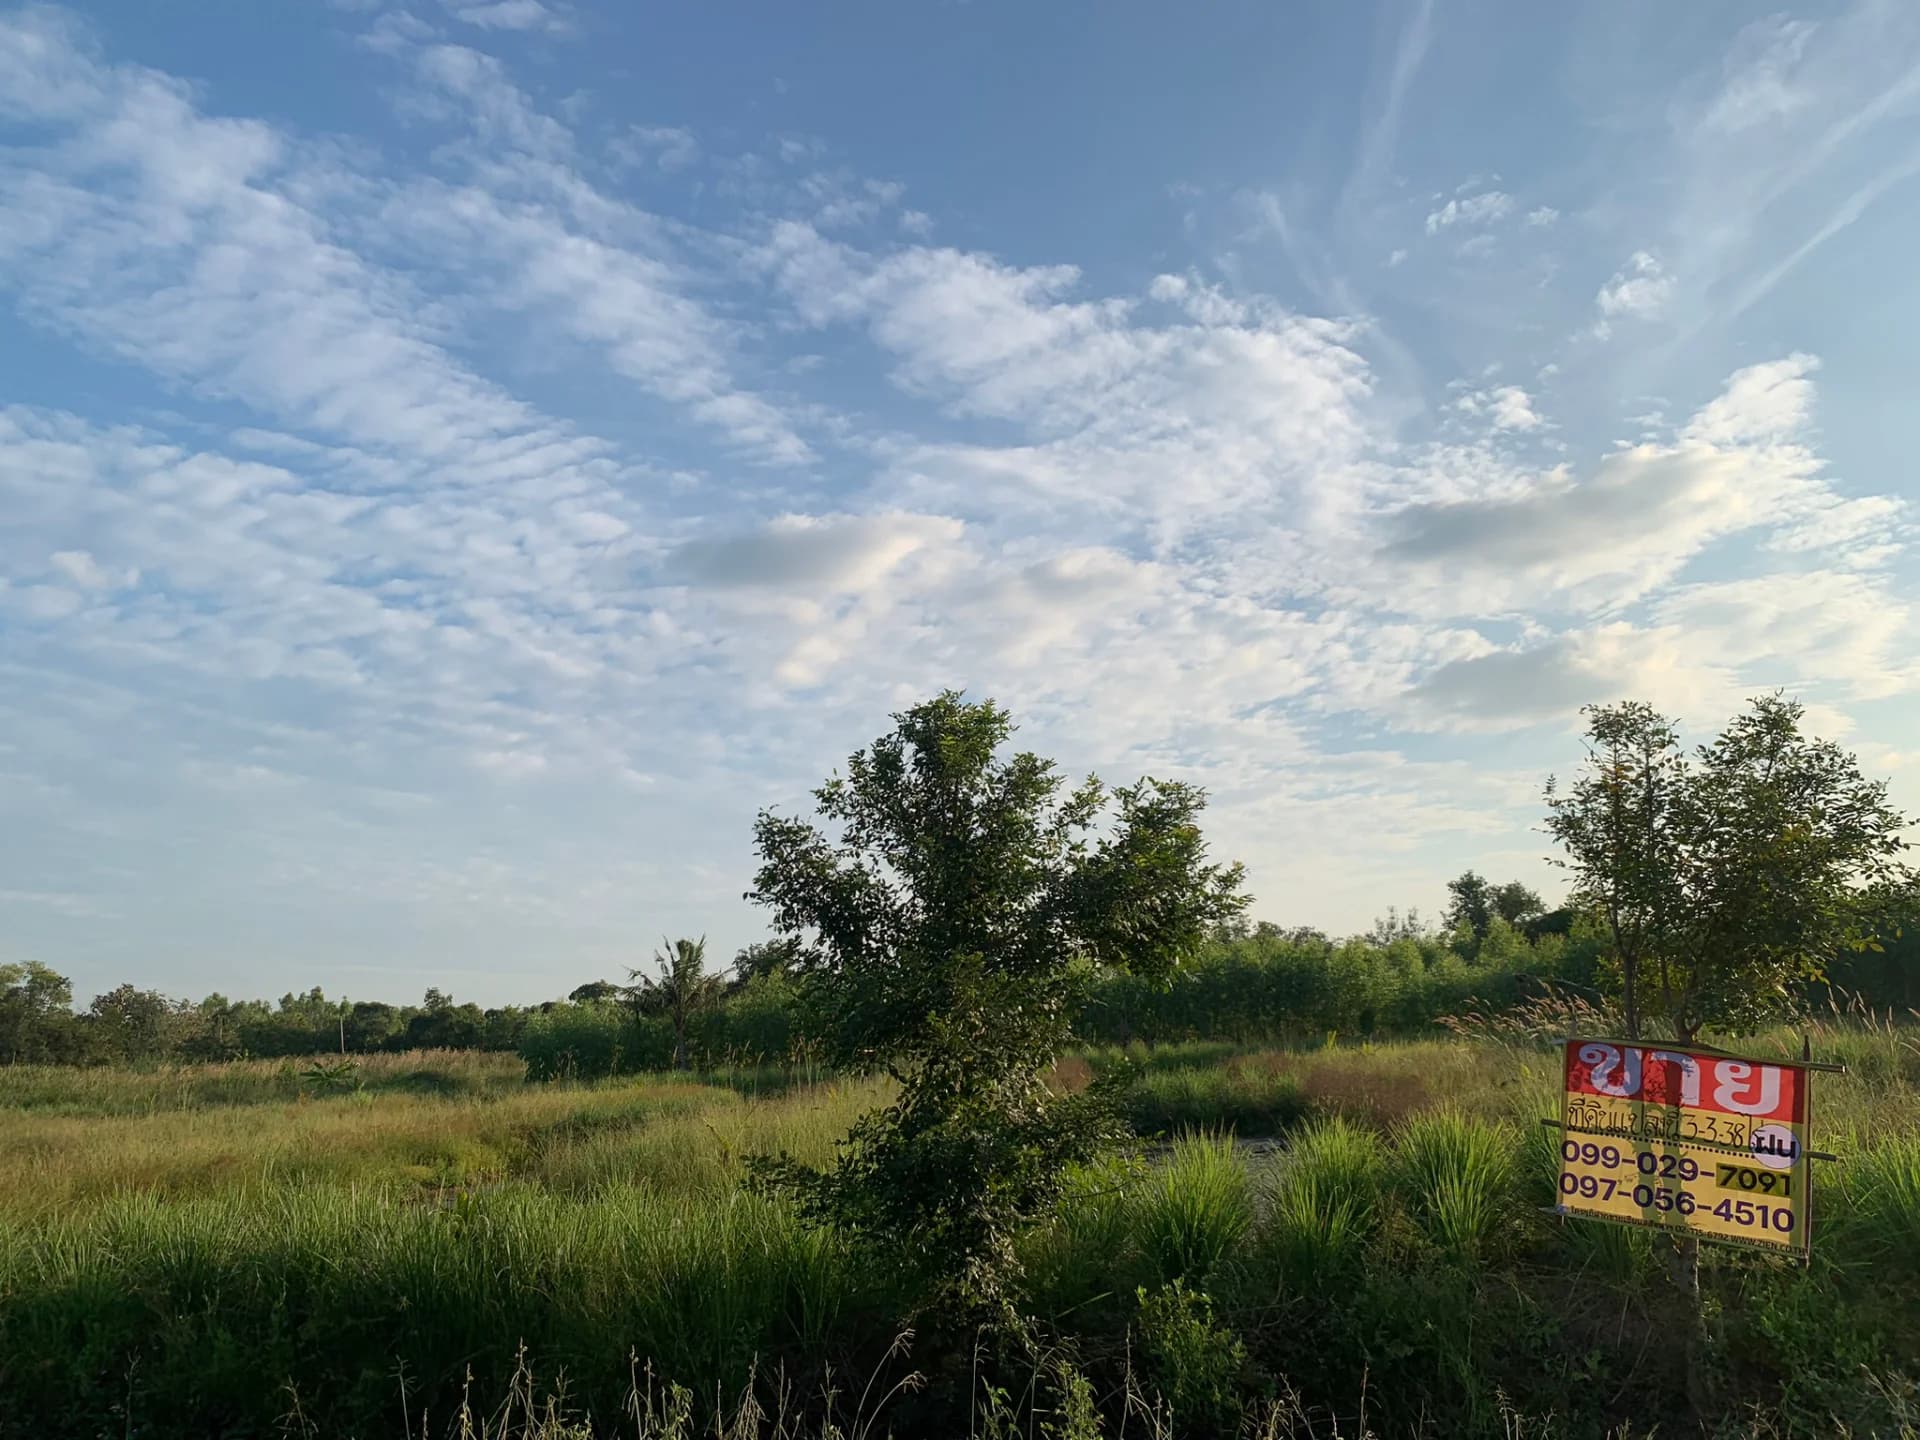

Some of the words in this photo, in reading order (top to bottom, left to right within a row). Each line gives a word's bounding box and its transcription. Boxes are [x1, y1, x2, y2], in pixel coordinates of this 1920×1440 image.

[1579, 1044, 1780, 1116] ขาย
[1560, 1139, 1791, 1196] 099-029-7091
[1559, 1172, 1795, 1233] 097-056-4510
